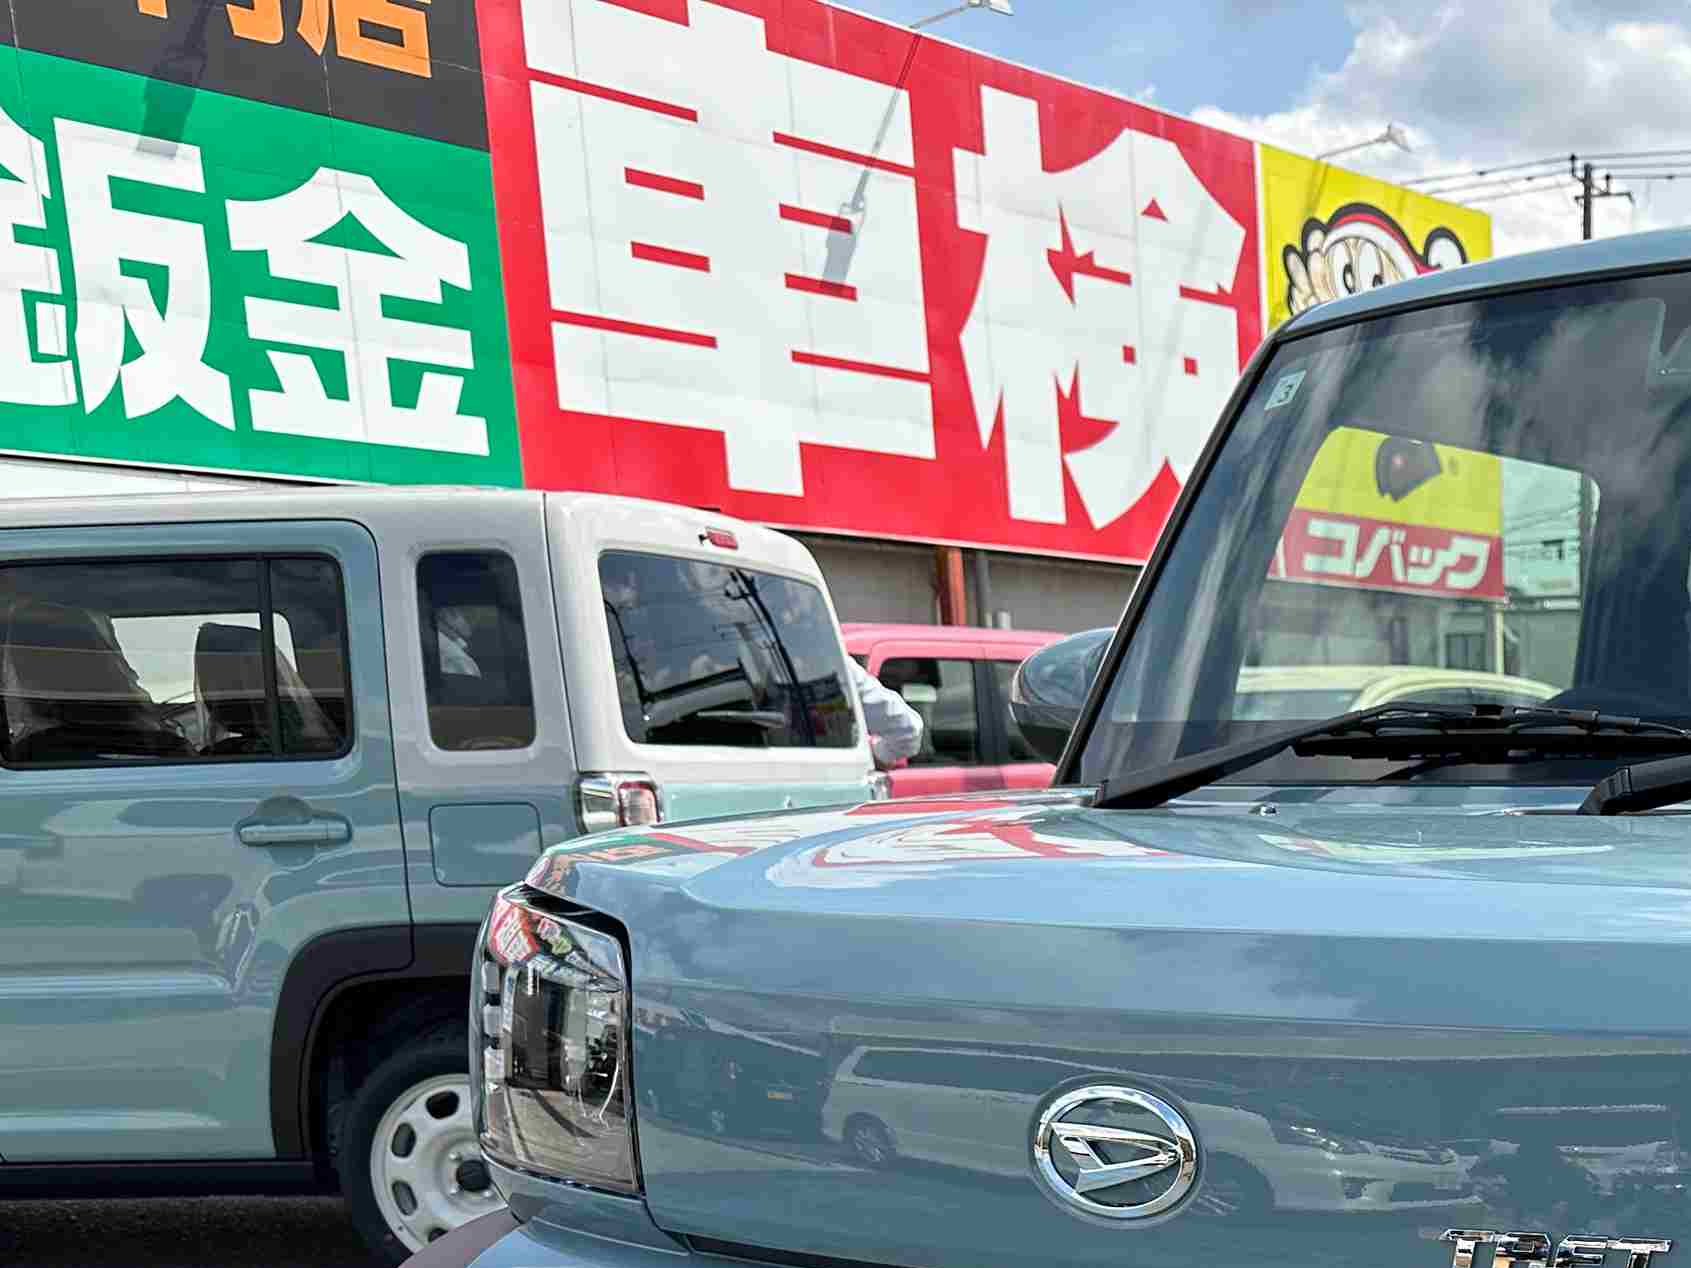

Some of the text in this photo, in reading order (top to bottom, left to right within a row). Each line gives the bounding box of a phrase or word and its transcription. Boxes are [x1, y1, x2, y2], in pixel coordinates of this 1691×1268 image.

[522, 0, 1246, 529] 車検
[1302, 517, 1491, 590] コバック
